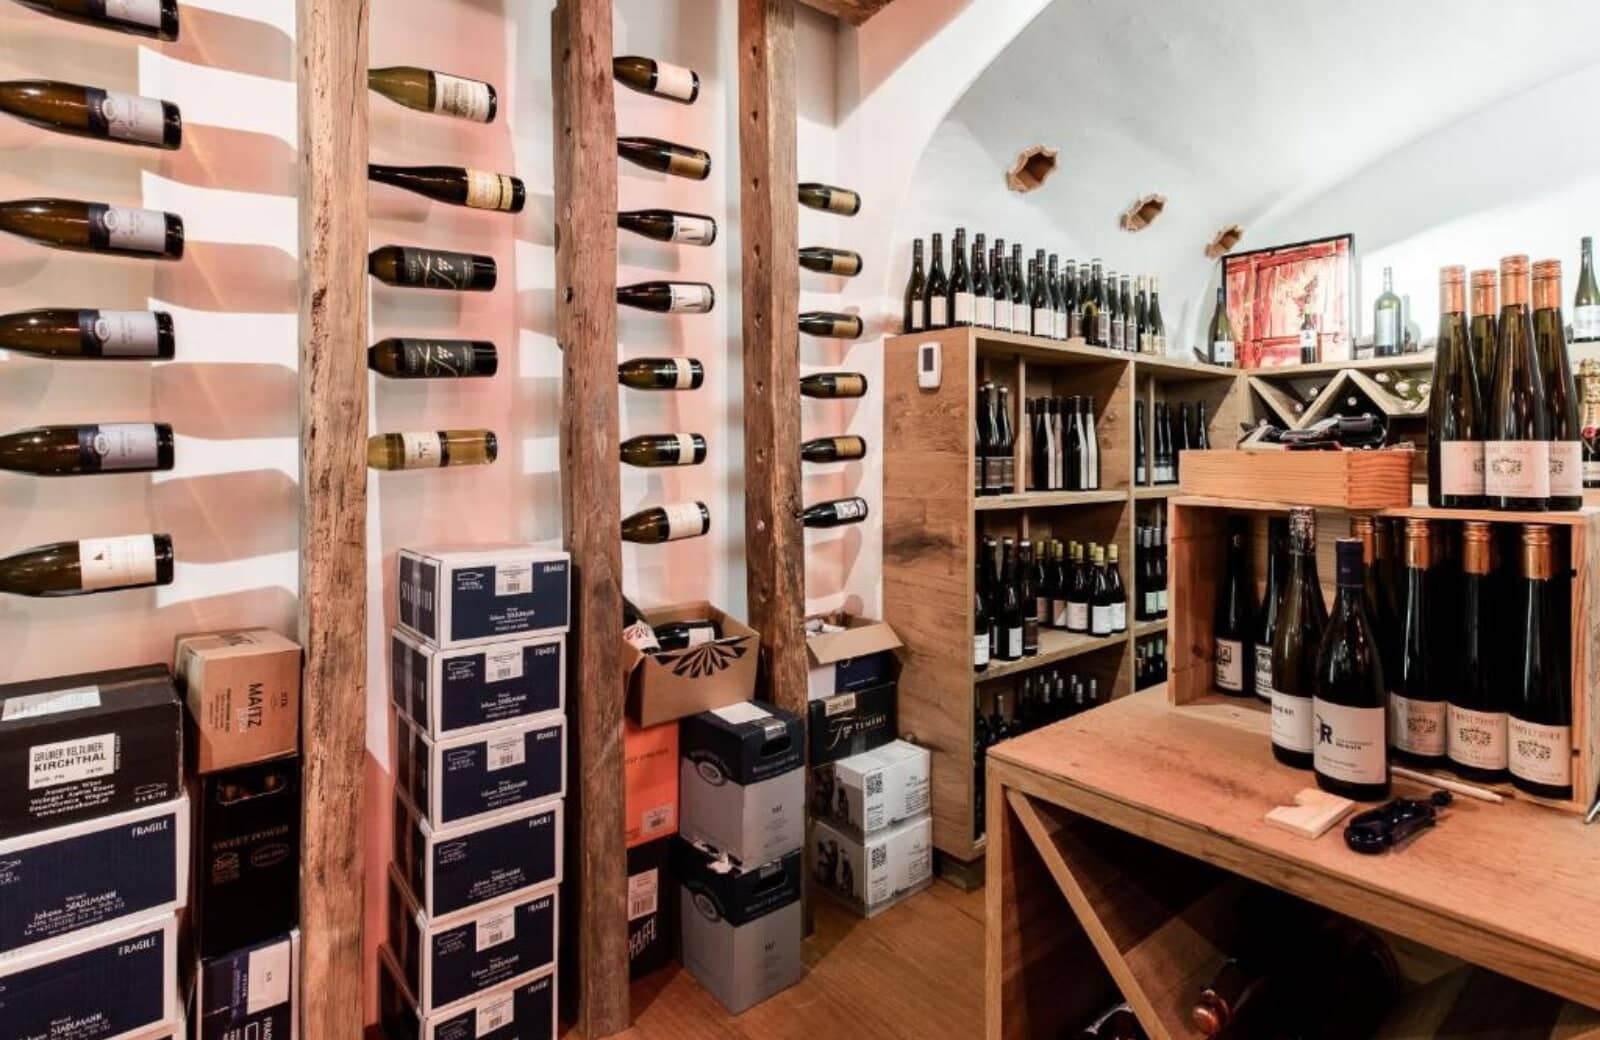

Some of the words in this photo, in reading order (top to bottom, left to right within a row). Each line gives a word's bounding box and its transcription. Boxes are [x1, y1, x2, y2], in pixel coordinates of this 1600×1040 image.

[247, 682, 263, 728] MAITZ
[1320, 722, 1333, 745] R
[33, 752, 107, 773] KIRCHTHAL
[131, 820, 168, 839] FRAGILE
[251, 823, 289, 841] POWER
[118, 936, 157, 956] FRAGILE
